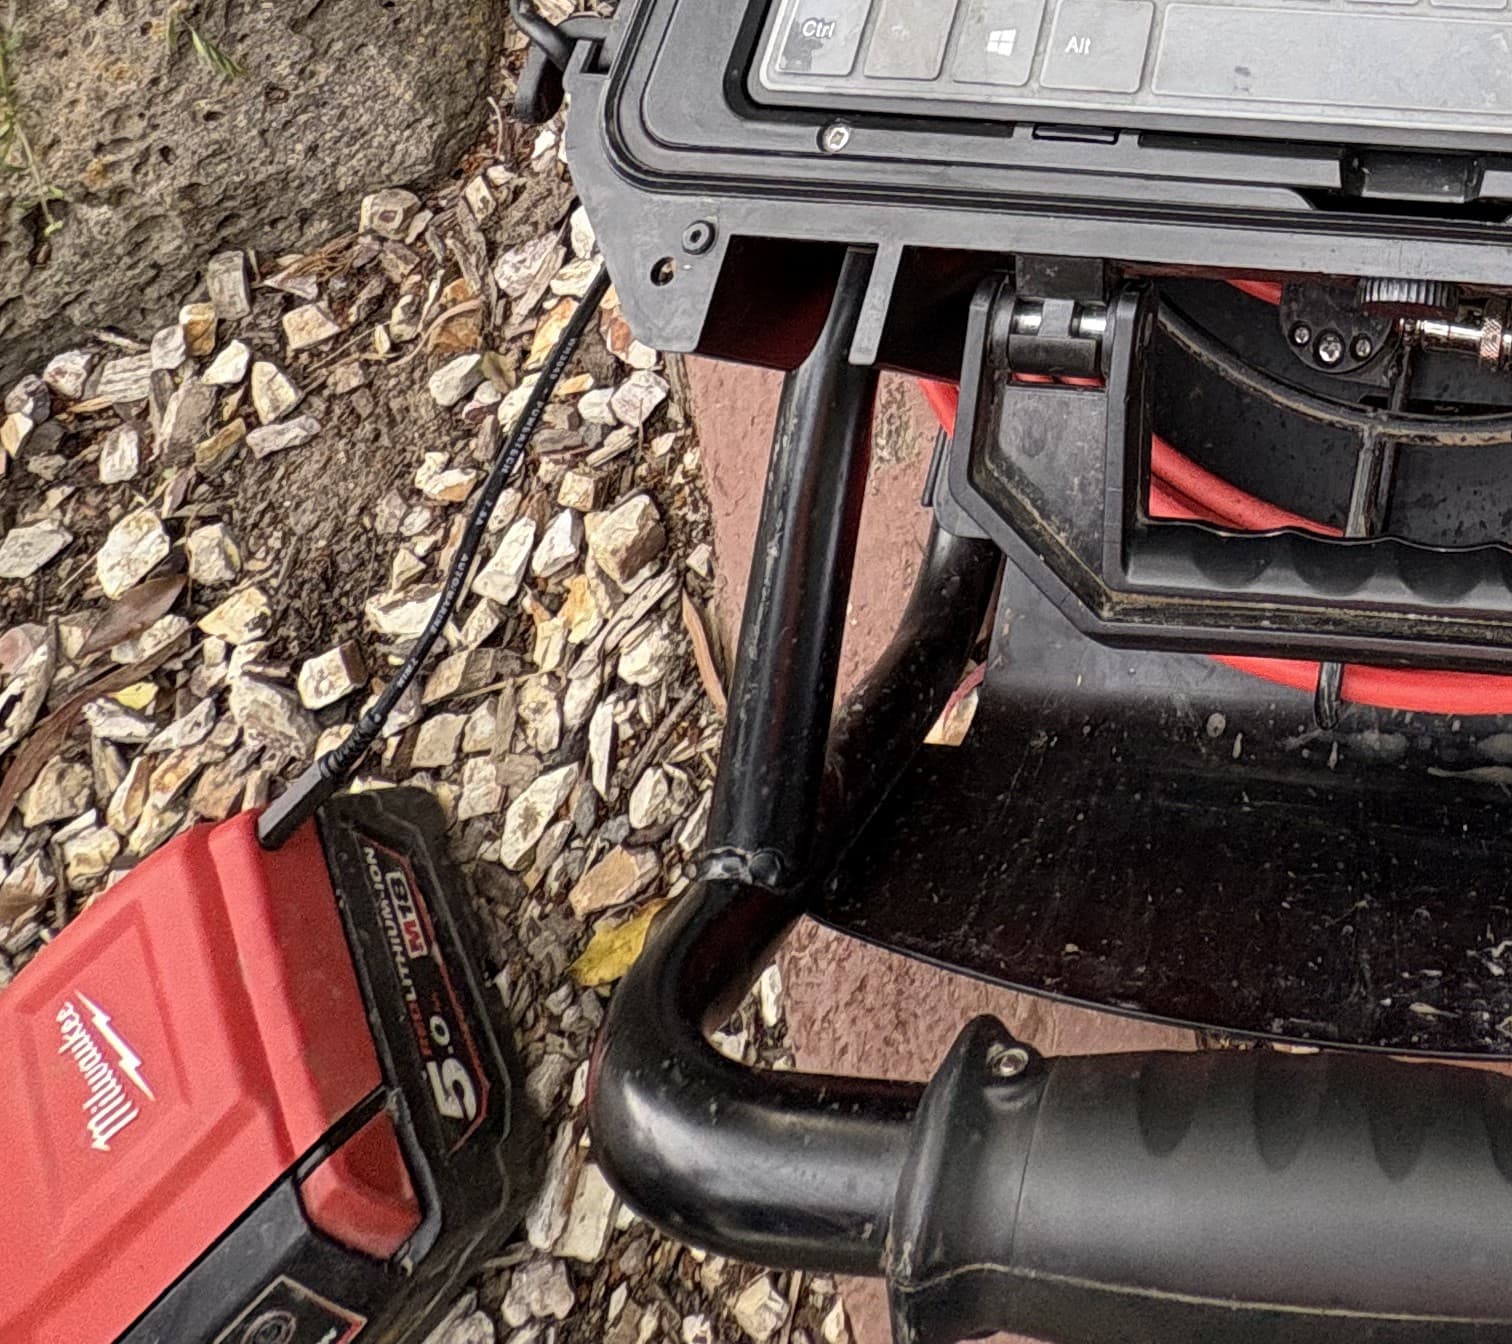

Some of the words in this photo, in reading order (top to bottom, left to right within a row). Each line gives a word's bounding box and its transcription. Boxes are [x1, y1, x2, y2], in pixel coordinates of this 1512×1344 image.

[802, 20, 837, 39] Ctrl
[1065, 35, 1092, 55] Alt
[390, 876, 425, 955] M18
[55, 1000, 140, 1152] Milwaukee
